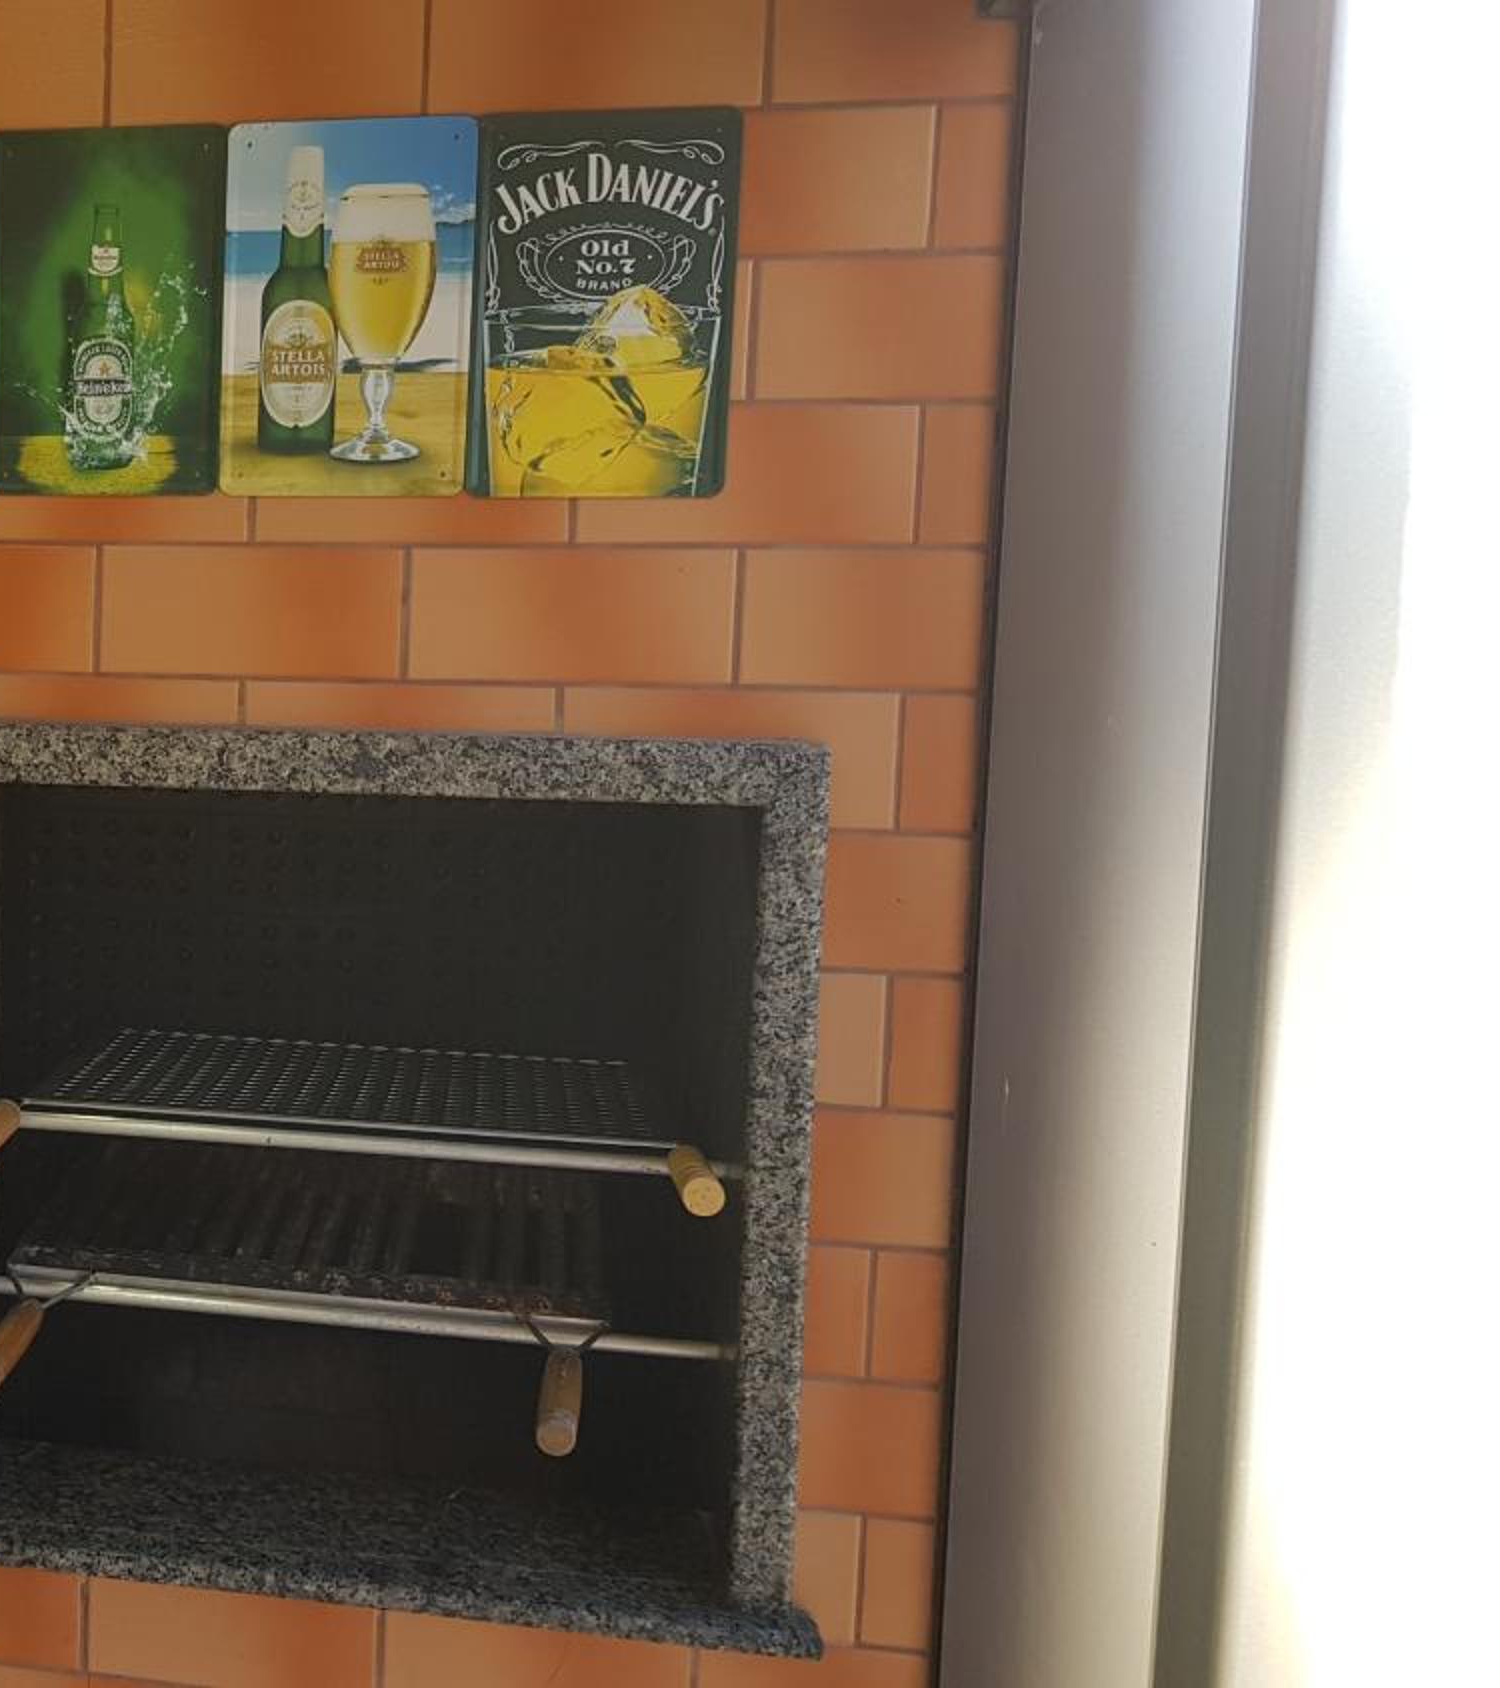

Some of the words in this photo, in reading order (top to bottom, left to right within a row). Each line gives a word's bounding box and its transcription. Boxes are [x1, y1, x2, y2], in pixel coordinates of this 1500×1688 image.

[495, 167, 582, 235] JACK
[587, 152, 725, 231] DANIEL'S
[580, 239, 630, 258] Old
[575, 278, 634, 291] BRAND
[272, 351, 326, 363] STELLA
[271, 363, 326, 376] ARTOIS
